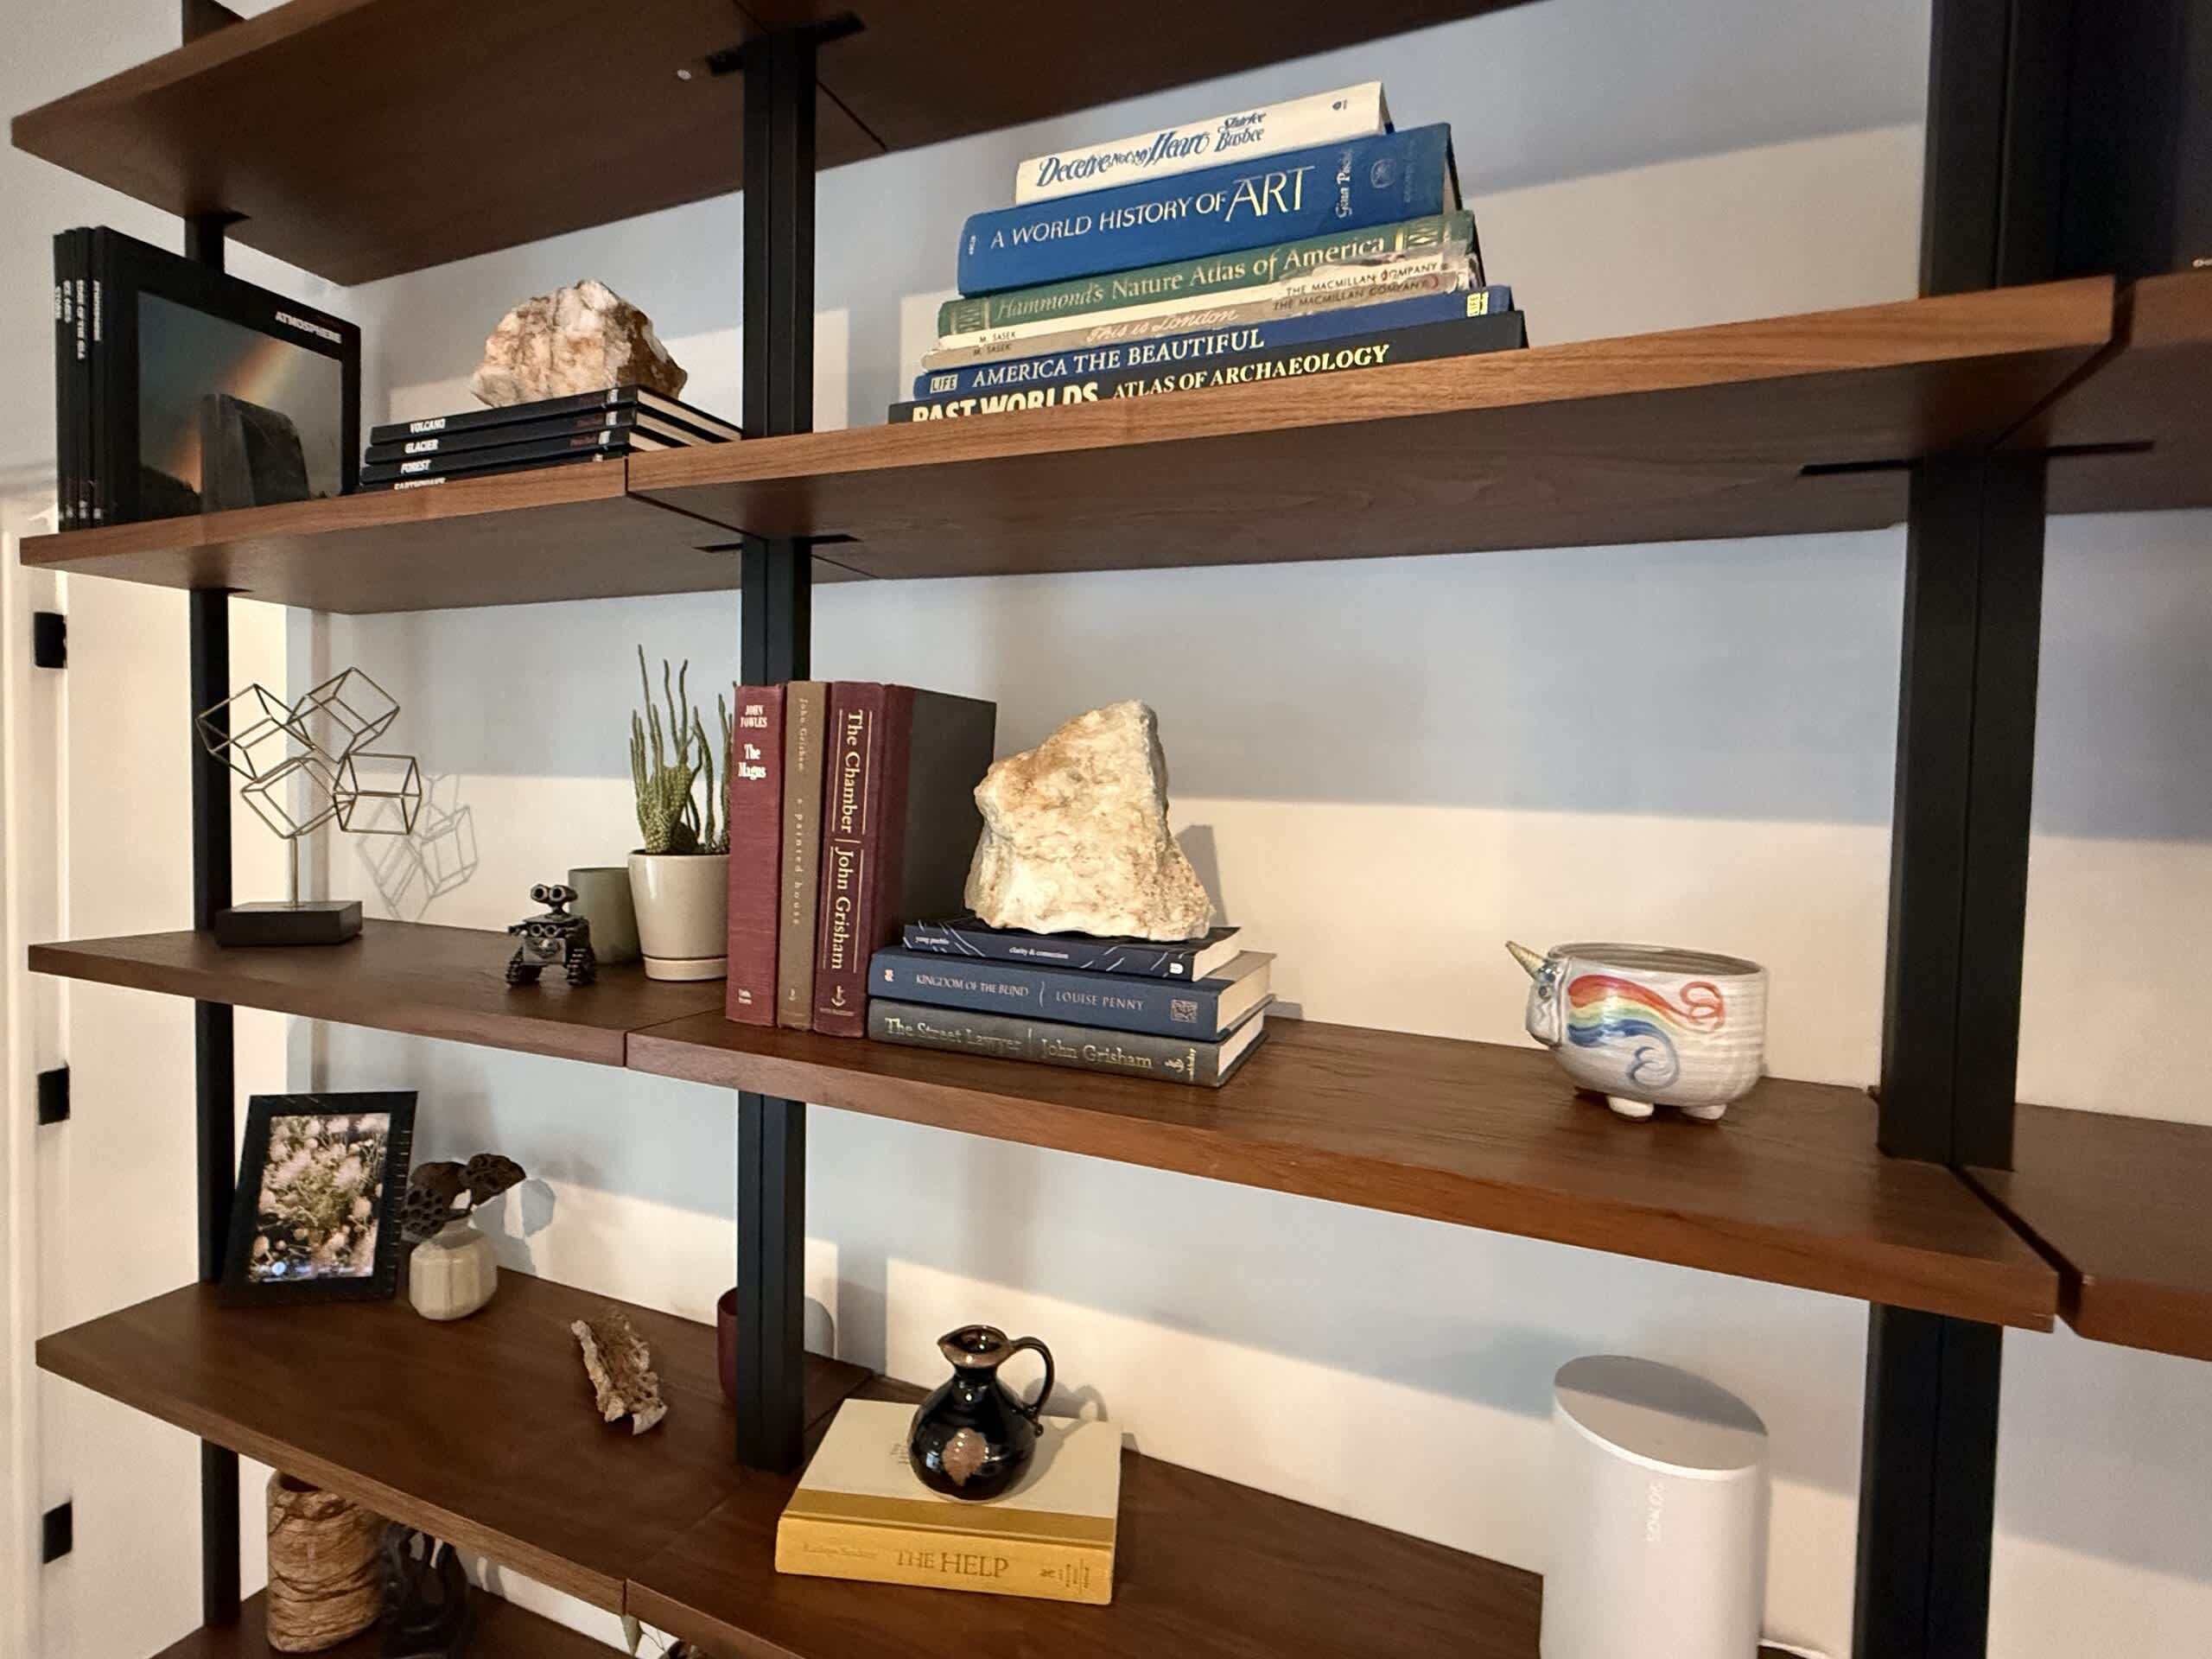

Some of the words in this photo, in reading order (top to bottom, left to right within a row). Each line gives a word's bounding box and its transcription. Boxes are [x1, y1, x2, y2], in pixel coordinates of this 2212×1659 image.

[1215, 128, 1265, 152] Busbee
[990, 230, 1004, 249] A
[1012, 216, 1091, 245] WORLD
[1099, 195, 1193, 232] HISTORY
[1195, 190, 1228, 214] OF
[1224, 165, 1316, 222] ART
[996, 283, 1103, 320] Hammond's
[1112, 271, 1183, 300] Nature
[1188, 262, 1246, 287] Atlas
[1254, 248, 1281, 282] of
[1282, 236, 1385, 270] America
[1286, 286, 1306, 296] THE
[1311, 274, 1376, 292] MACMILLAN
[1380, 262, 1438, 281] COMPANY
[1274, 298, 1294, 310] THE
[1299, 289, 1364, 308] MACMILLAN
[275, 310, 342, 344] ATMOSPHERE
[1085, 325, 1128, 343] This
[1131, 321, 1149, 335] is
[1152, 308, 1239, 332] London
[931, 375, 957, 392] LIFE
[972, 359, 1067, 388] AMERICA
[1073, 350, 1121, 373] THE
[1127, 328, 1265, 366] BEAUTIFUL
[912, 399, 976, 423] PAST
[980, 382, 1098, 415] WORLDS
[1113, 374, 1176, 400] ATLAS
[1178, 371, 1208, 391] OF
[1210, 343, 1390, 387] ARCHAEOLOGY
[410, 417, 446, 434] VOLCANO
[404, 439, 439, 454] GLACIER
[400, 459, 432, 474] FOREST
[745, 704, 764, 716] JOHN
[847, 709, 863, 747] The
[744, 743, 761, 760] The
[738, 761, 767, 780] Magus
[841, 751, 861, 834] Chamber
[834, 847, 854, 890] John
[831, 897, 851, 970] Grisham
[916, 974, 963, 990] KINGDOM
[965, 981, 977, 991] OF
[980, 982, 996, 994] THE
[998, 985, 1030, 997] BLIND
[1056, 991, 1098, 1006] LOUISE
[1102, 996, 1145, 1010] PENNY
[884, 1017, 913, 1037] The
[1041, 1038, 1078, 1059] John
[1082, 1044, 1154, 1070] Grisham
[897, 1549, 934, 1569] THE
[939, 1551, 1009, 1579] HELP
